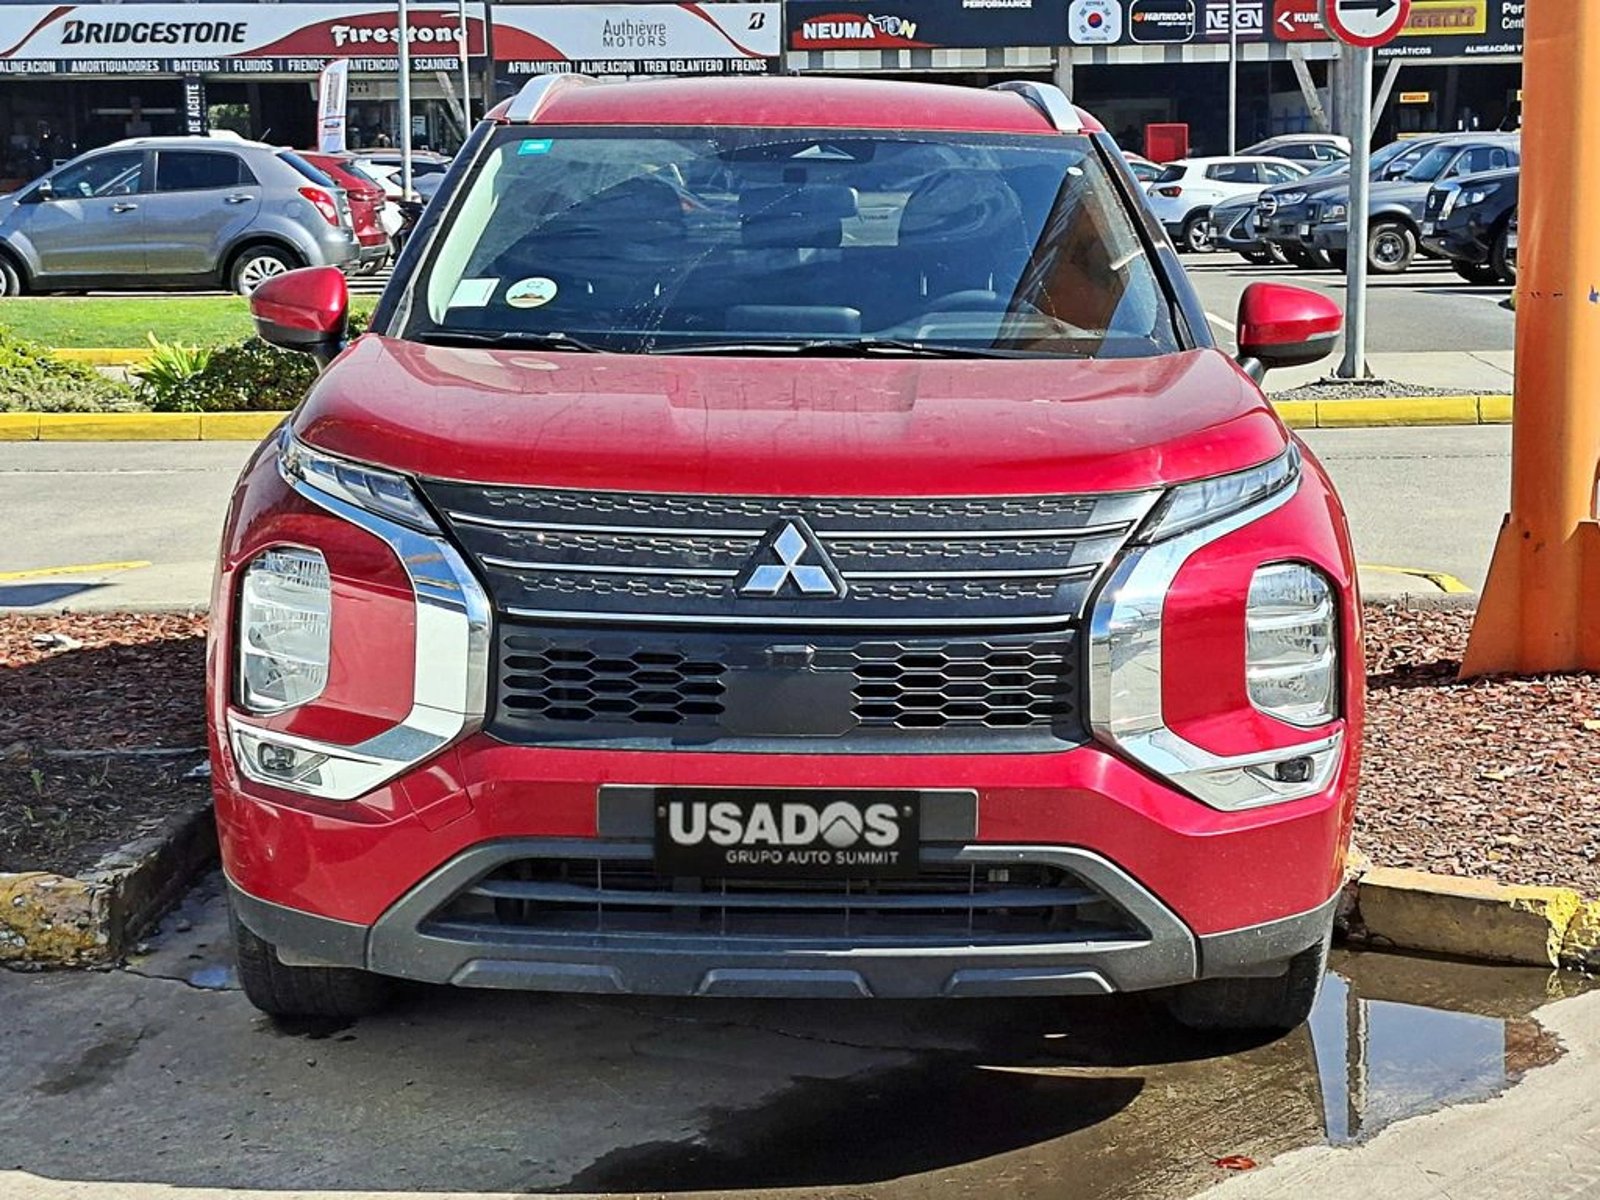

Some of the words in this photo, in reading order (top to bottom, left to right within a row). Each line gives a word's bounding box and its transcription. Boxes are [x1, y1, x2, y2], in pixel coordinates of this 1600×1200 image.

[61, 20, 248, 44] BRIDGESTONE
[602, 36, 667, 47] MOTORS
[0, 60, 56, 73] ALINEACION
[71, 60, 160, 73] AMORTIGUADORES
[174, 60, 220, 72] BATERIAS
[233, 59, 273, 72] FLUIDOS
[288, 59, 326, 72] FRENOS
[414, 58, 459, 70] SCANNER
[507, 61, 572, 74] AFINAMIENTO
[580, 60, 635, 73] ALINEACION
[643, 60, 669, 72] TREN
[670, 59, 723, 72] DELANTERO
[731, 58, 767, 71] FRENOS
[186, 84, 201, 117] ACEITE
[188, 120, 201, 132] DE
[669, 801, 900, 848] USADOS
[726, 851, 783, 864] GRUPO
[787, 851, 831, 864] AUTO
[835, 851, 899, 865] SUMMIT
